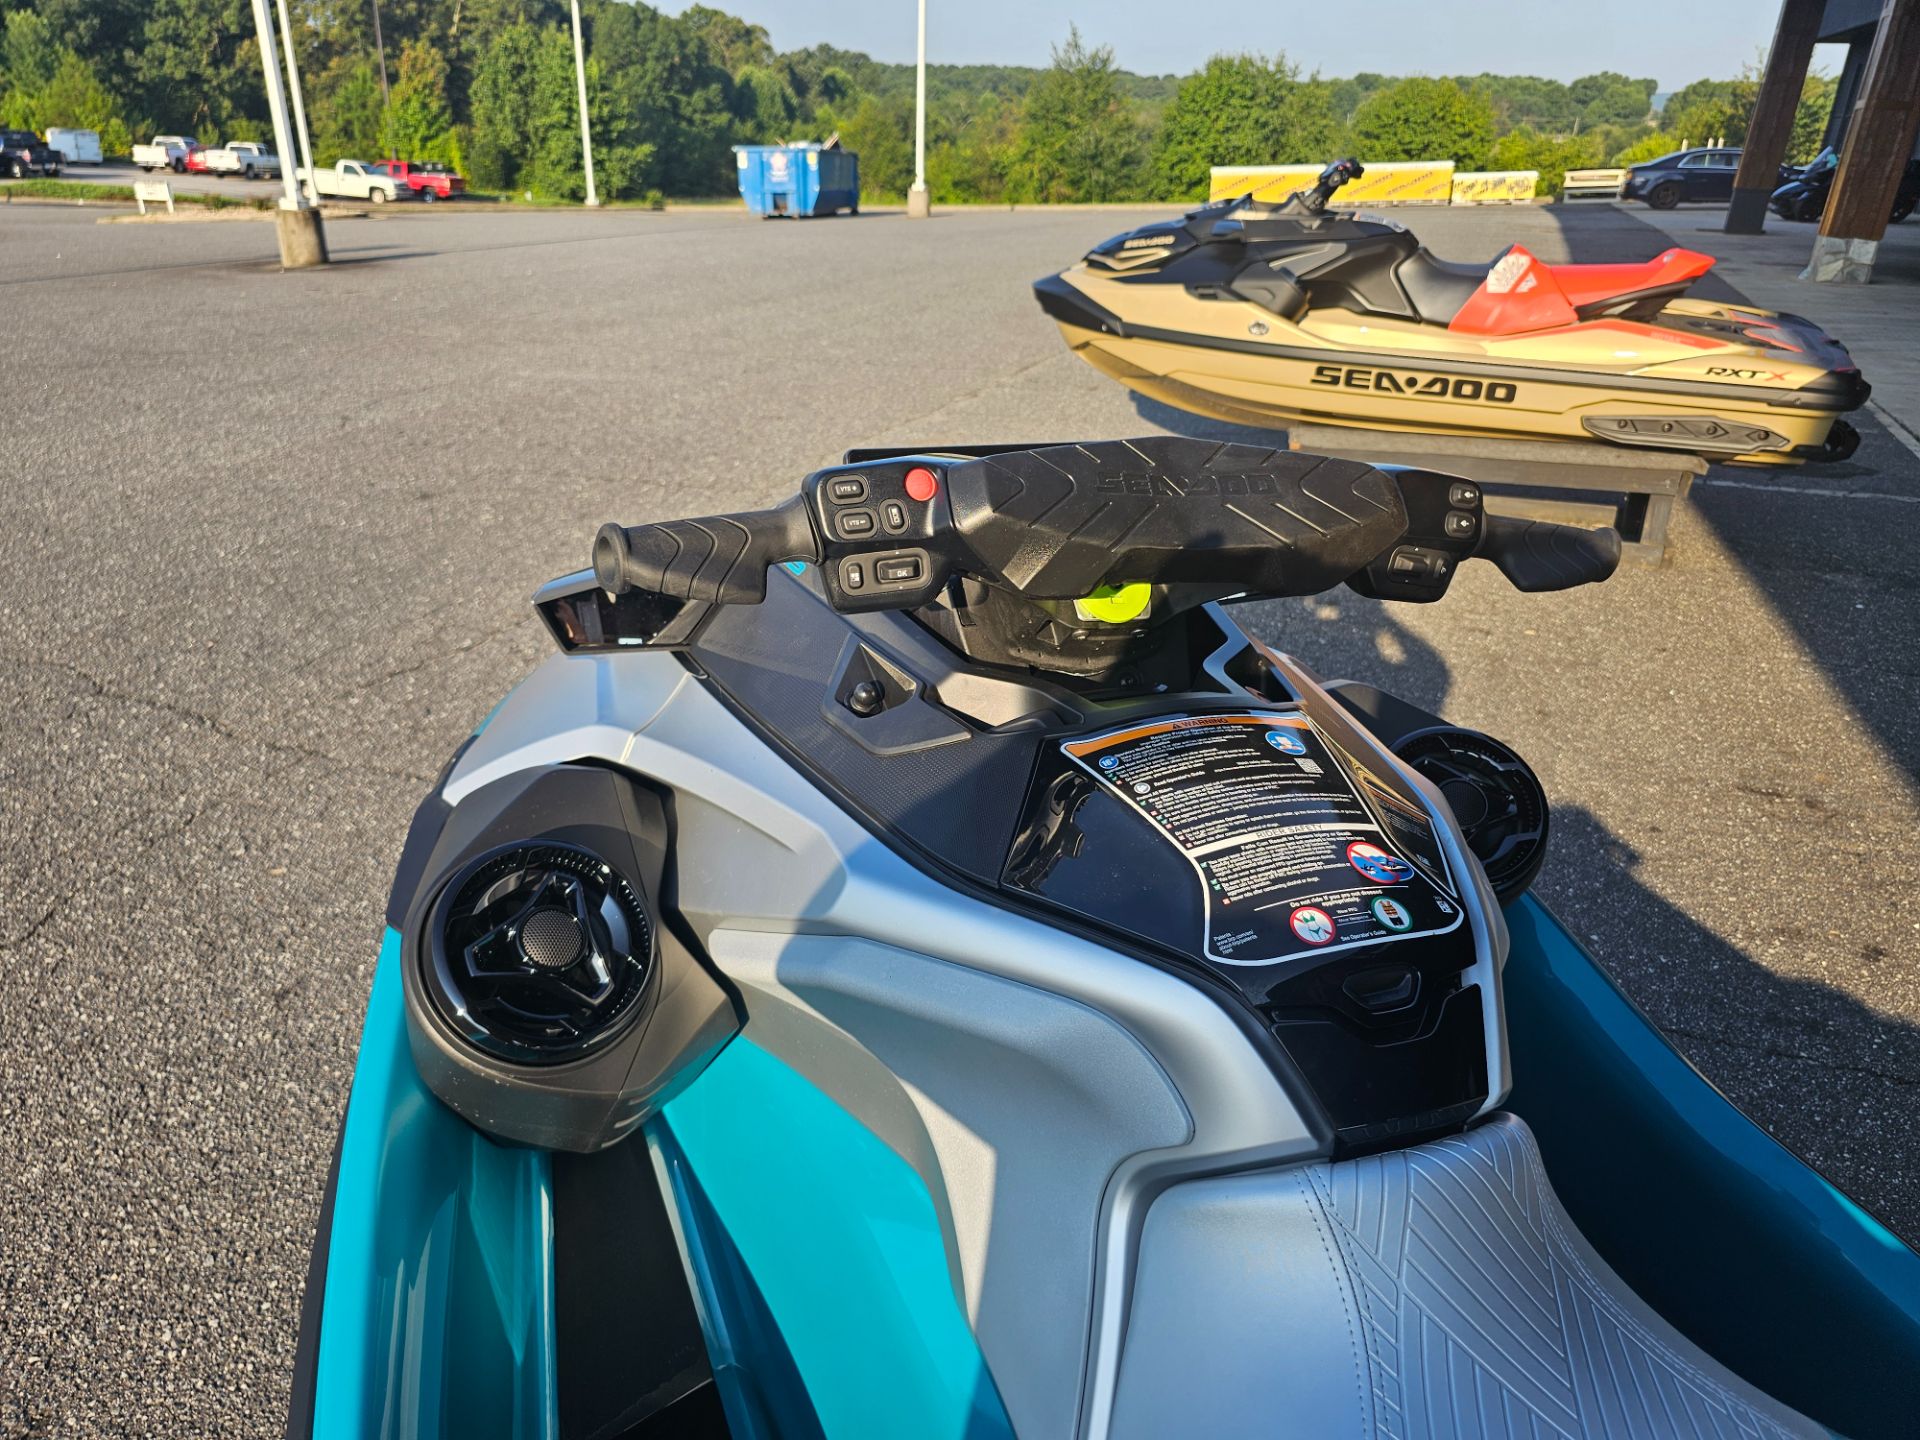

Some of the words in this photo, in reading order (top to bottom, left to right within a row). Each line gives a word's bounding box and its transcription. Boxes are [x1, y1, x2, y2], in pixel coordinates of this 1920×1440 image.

[1182, 717, 1229, 729] WARNING
[1256, 827, 1285, 838] RIDER
[1288, 824, 1322, 833] SAFETY
